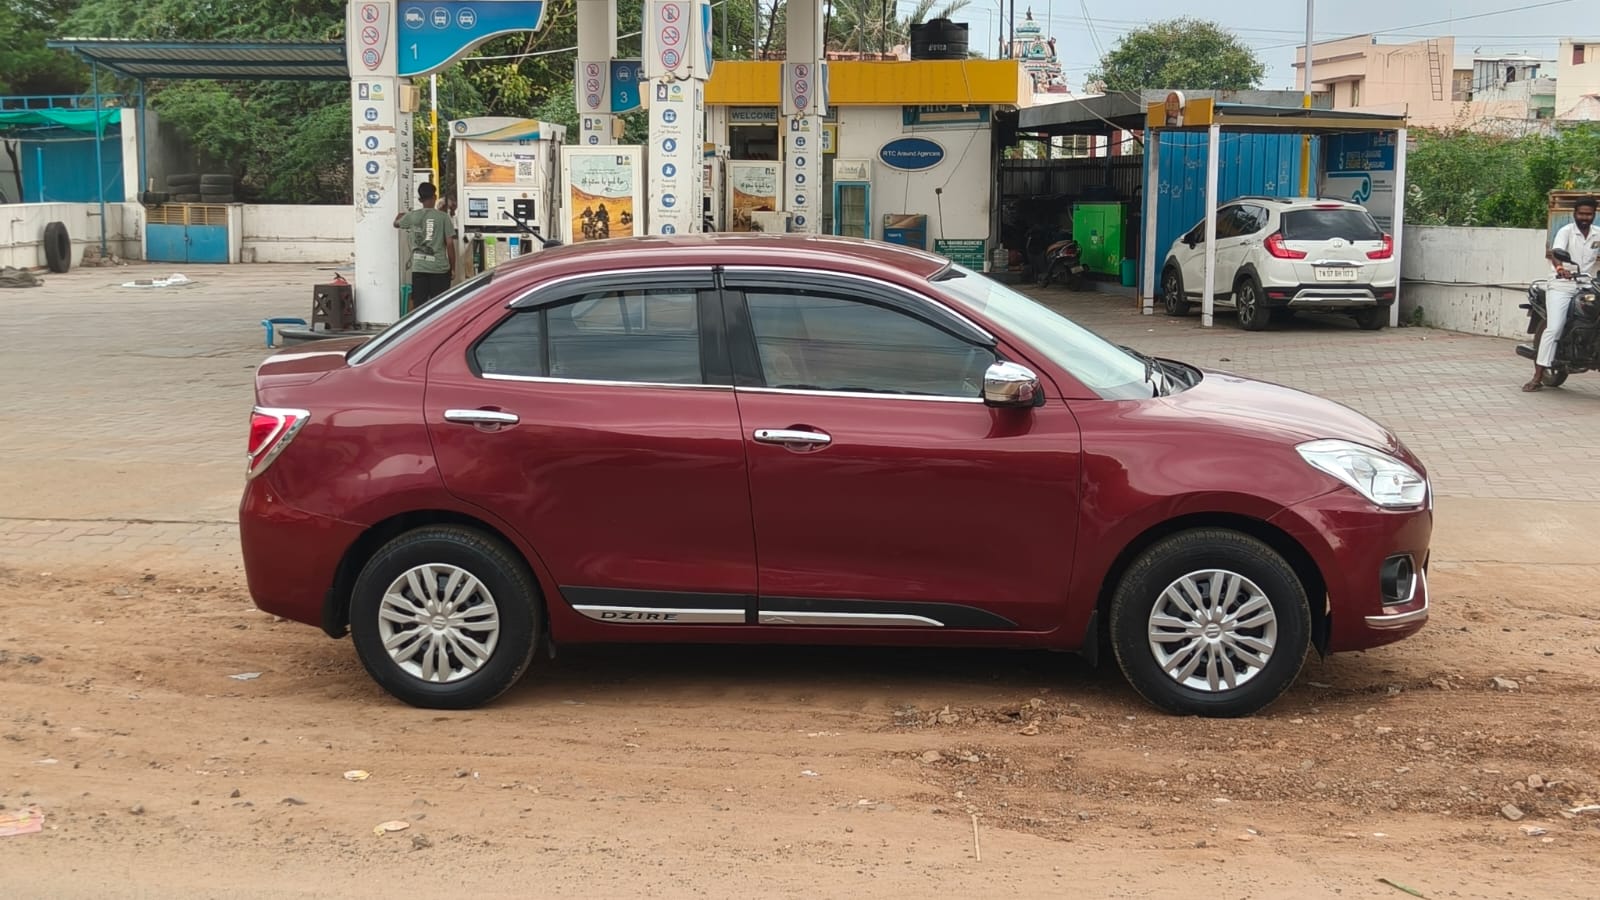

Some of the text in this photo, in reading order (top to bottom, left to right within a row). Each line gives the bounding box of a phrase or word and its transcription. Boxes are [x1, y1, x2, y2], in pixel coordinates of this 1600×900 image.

[410, 43, 419, 60] 1
[620, 91, 628, 103] 3
[731, 111, 776, 120] WELCOME
[601, 611, 678, 621] DZIRE
